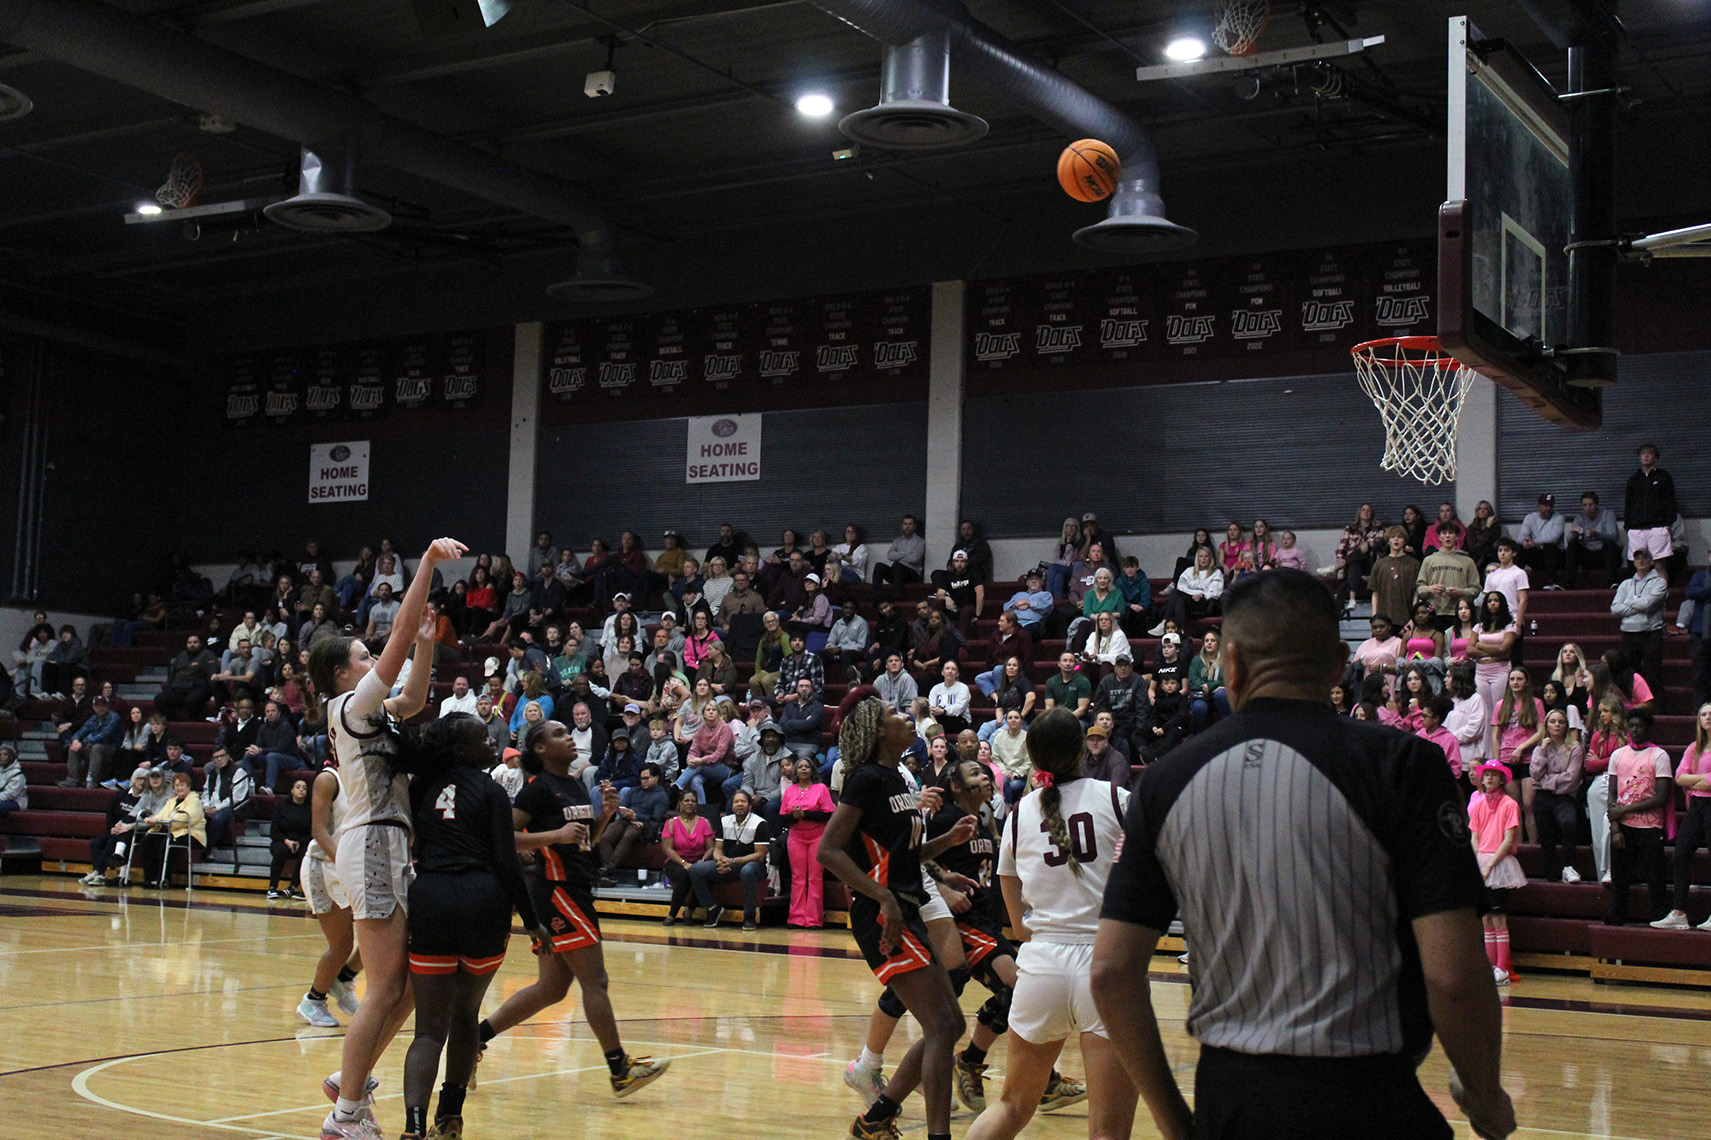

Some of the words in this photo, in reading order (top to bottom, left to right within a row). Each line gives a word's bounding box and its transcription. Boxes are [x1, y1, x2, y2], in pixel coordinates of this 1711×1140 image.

[1312, 287, 1342, 297] SOFTBALL
[1383, 281, 1421, 293] VOLLEYBALL
[1049, 313, 1067, 322] TRACK
[1109, 307, 1138, 316] SOFTBALL
[989, 318, 1006, 326] TRACK
[828, 332, 846, 341] TRACK
[700, 442, 748, 458] HOME
[320, 466, 358, 480] HOME
[688, 461, 759, 479] SEATING
[310, 483, 367, 499] SEATING
[1157, 666, 1178, 675] NIKE
[434, 783, 457, 820] 4
[1040, 811, 1098, 867] 30
